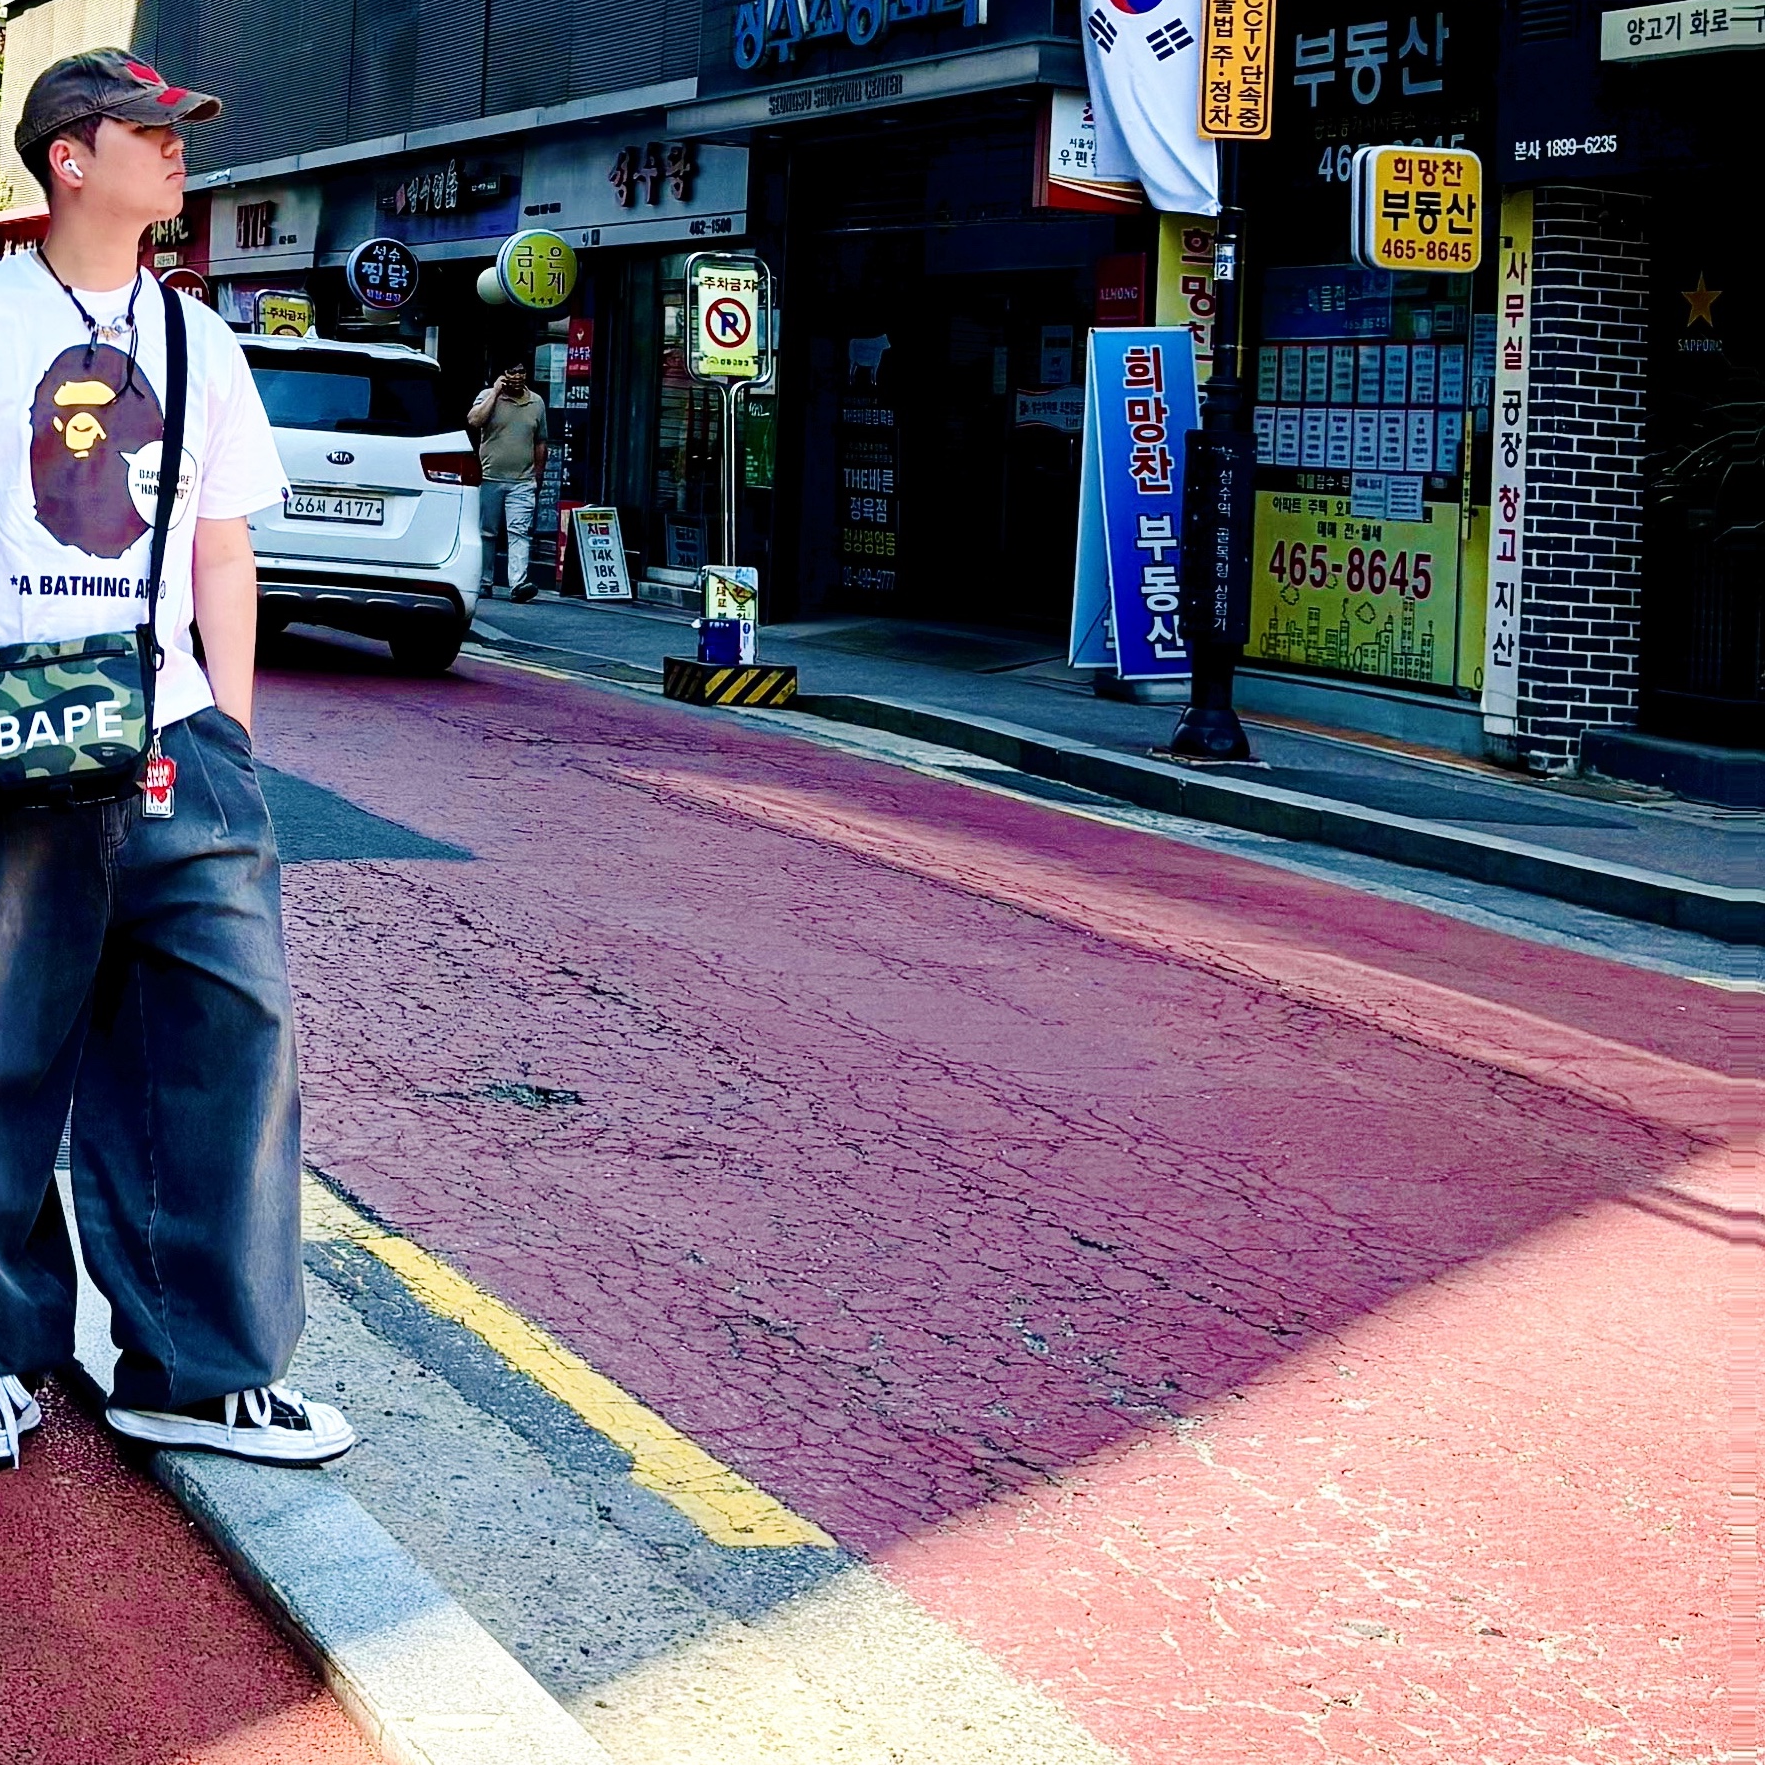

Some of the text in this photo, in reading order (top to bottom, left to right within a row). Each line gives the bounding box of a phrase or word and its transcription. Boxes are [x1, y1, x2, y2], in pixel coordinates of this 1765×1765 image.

[1627, 12, 1682, 45] 양고기
[1293, 11, 1450, 108] 부동산
[1209, 46, 1235, 129] 주·정차
[1058, 149, 1096, 168] 우편
[1514, 135, 1618, 162] 본사 1899-6235
[1393, 156, 1464, 187] 희망찬
[1382, 188, 1477, 235] 부동산
[372, 245, 401, 263] 성수
[1382, 239, 1472, 262] 465-8645
[361, 261, 410, 289] 찜닭
[515, 270, 566, 297] 시계
[1503, 251, 1527, 370] 사무실
[1124, 344, 1174, 495] 희망찬
[1501, 390, 1522, 469] 공장
[295, 496, 374, 518] 66서 4177
[849, 496, 887, 523] 정육점
[1496, 485, 1520, 563] 창고
[591, 549, 614, 562] 14K
[594, 565, 617, 578] 18K
[1269, 540, 1432, 600] 465-8645
[40, 575, 130, 598] BATHING
